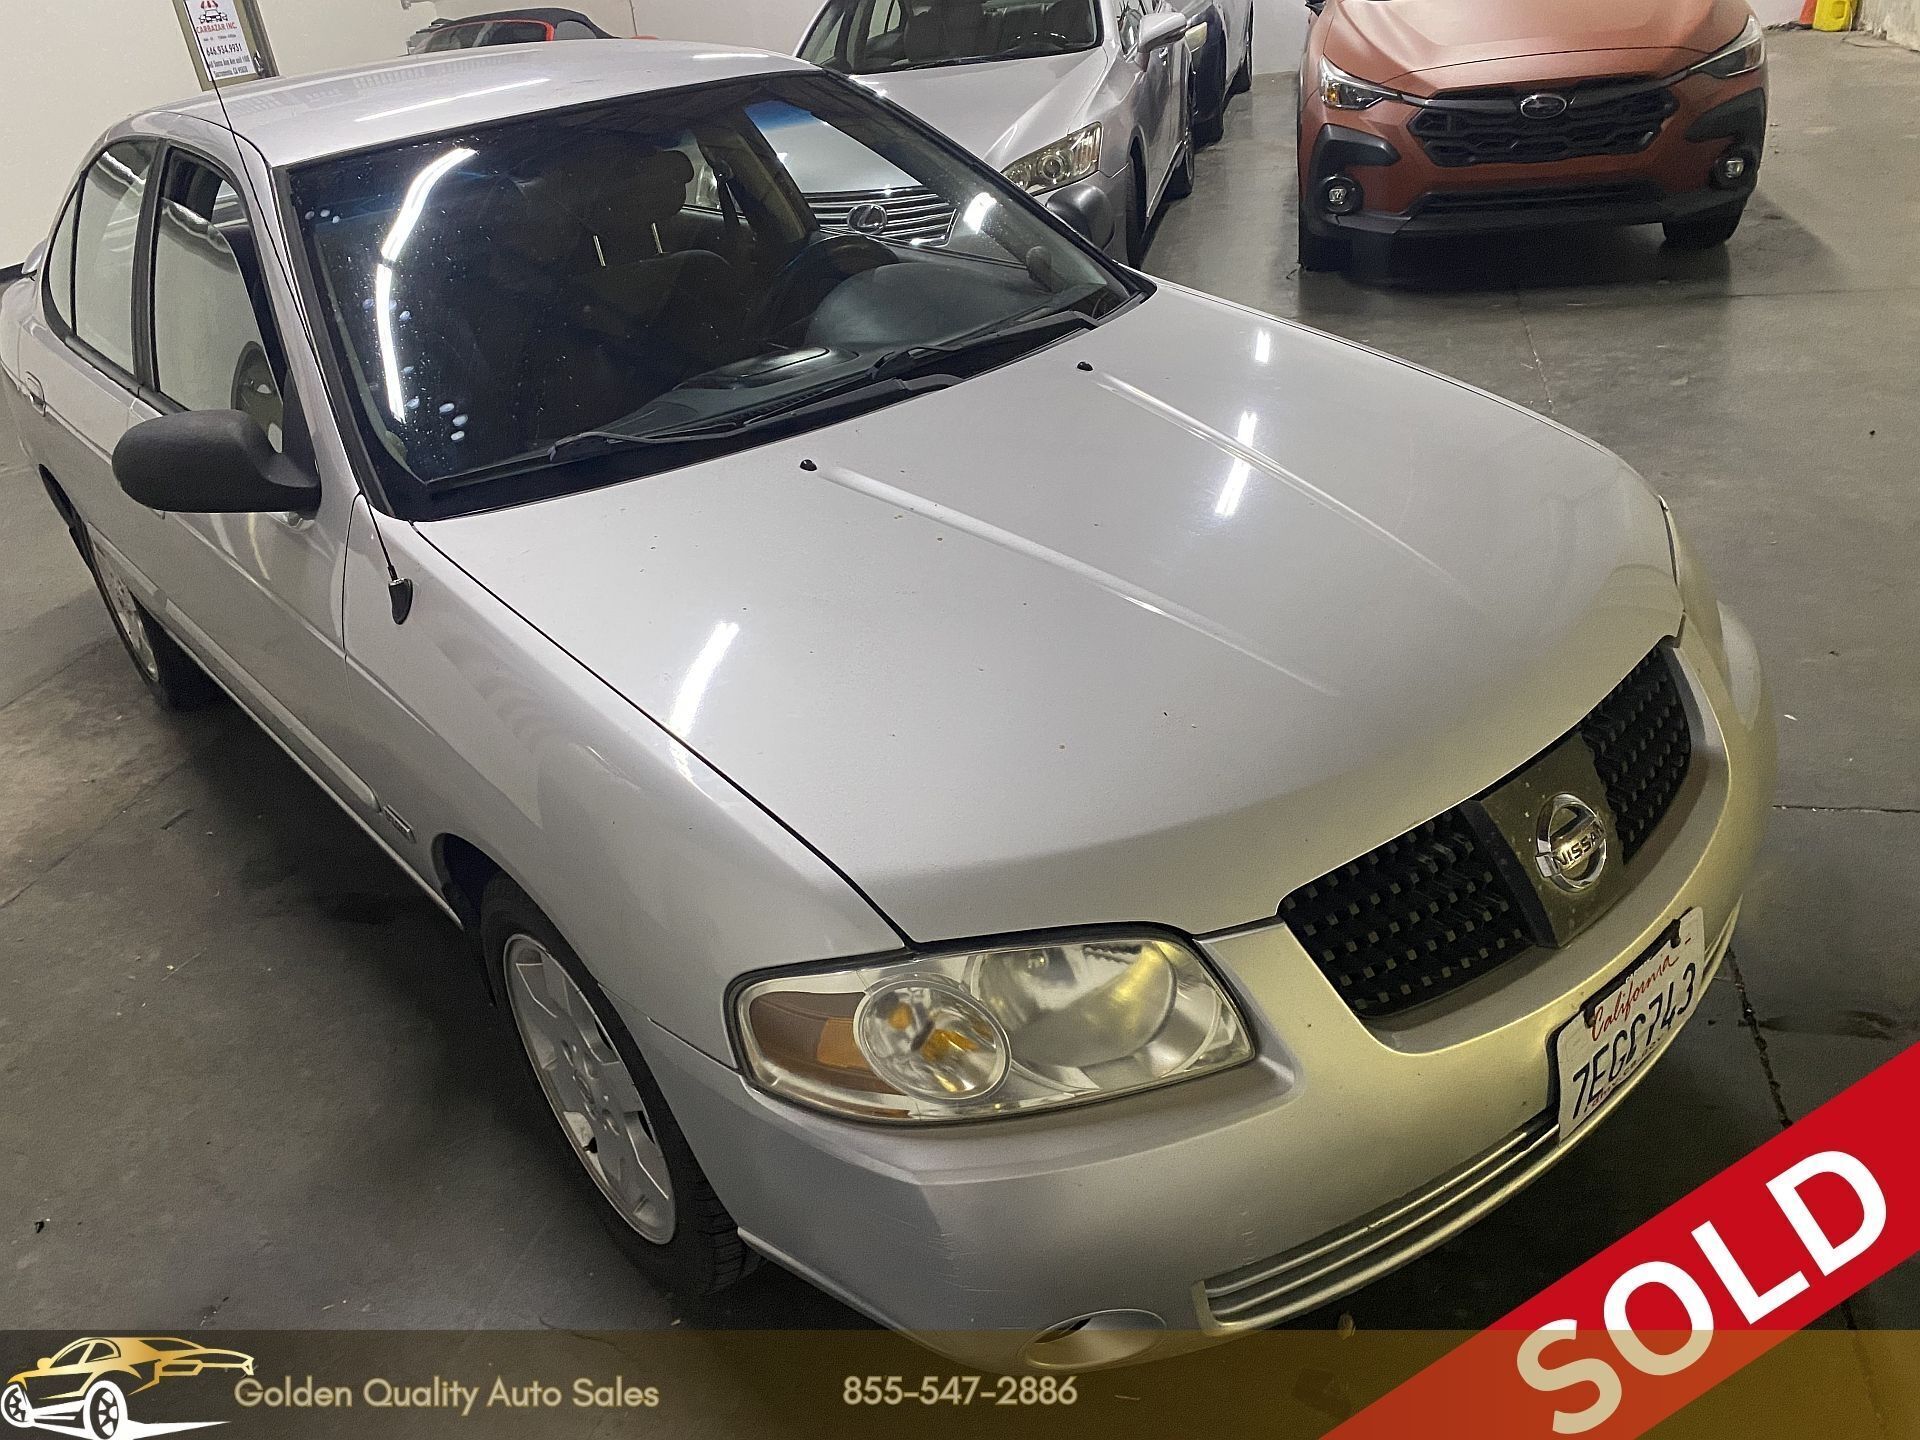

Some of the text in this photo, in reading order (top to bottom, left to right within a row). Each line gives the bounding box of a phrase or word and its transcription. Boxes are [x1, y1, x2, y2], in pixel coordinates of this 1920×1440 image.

[196, 23, 226, 34] CARBAZAR
[1552, 821, 1604, 871] NISSAN
[1591, 954, 1680, 1041] California
